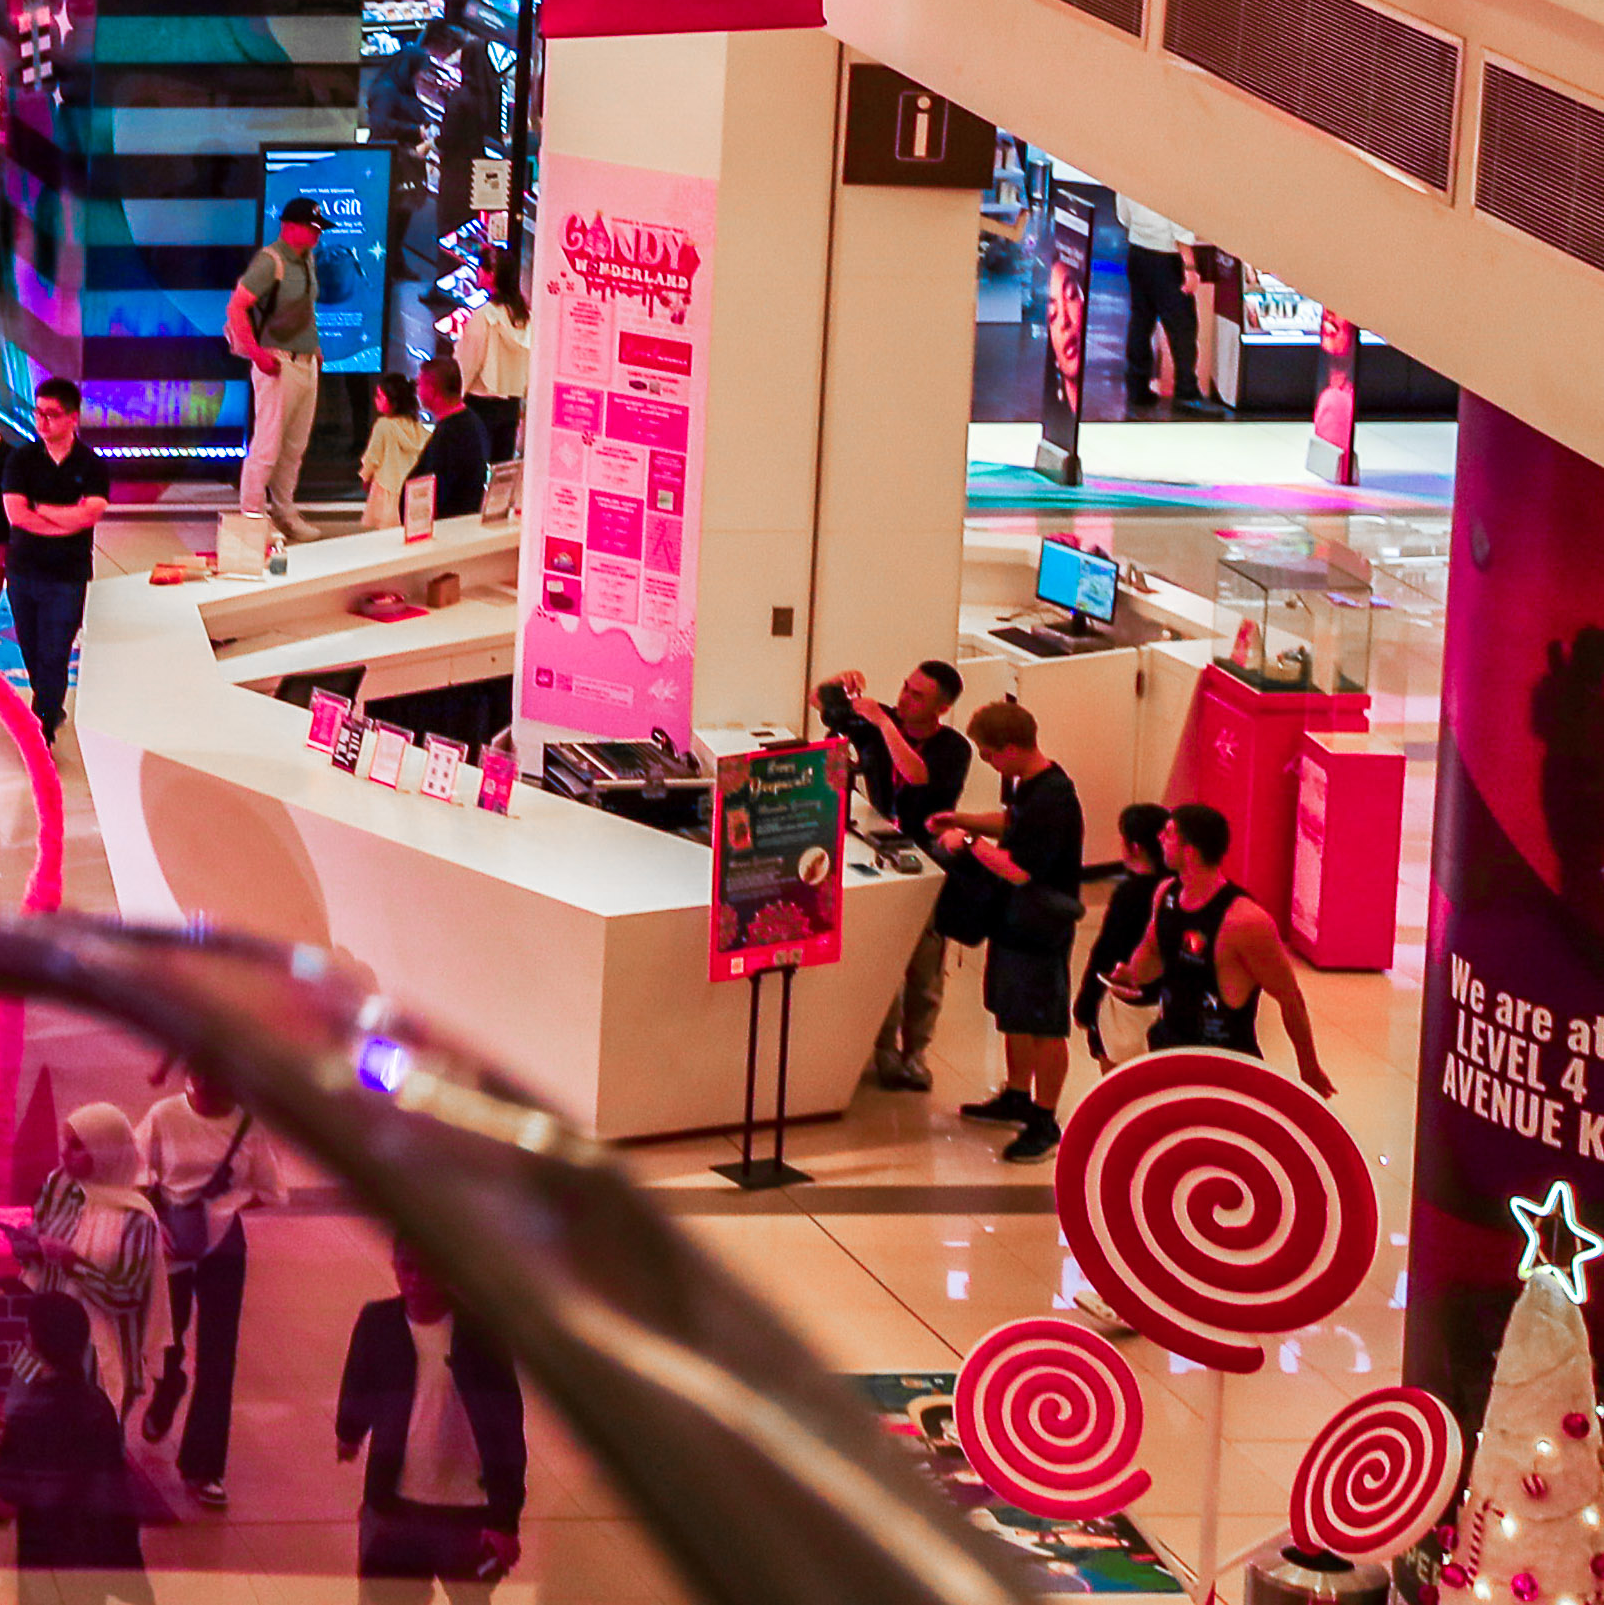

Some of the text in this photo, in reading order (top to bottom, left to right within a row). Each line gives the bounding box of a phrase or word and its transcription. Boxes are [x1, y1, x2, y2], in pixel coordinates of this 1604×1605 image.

[1451, 952, 1486, 1014] We
[1495, 983, 1553, 1044] are
[1454, 1009, 1588, 1105] LEVEL 4
[1442, 1050, 1604, 1162] AVENUE K
